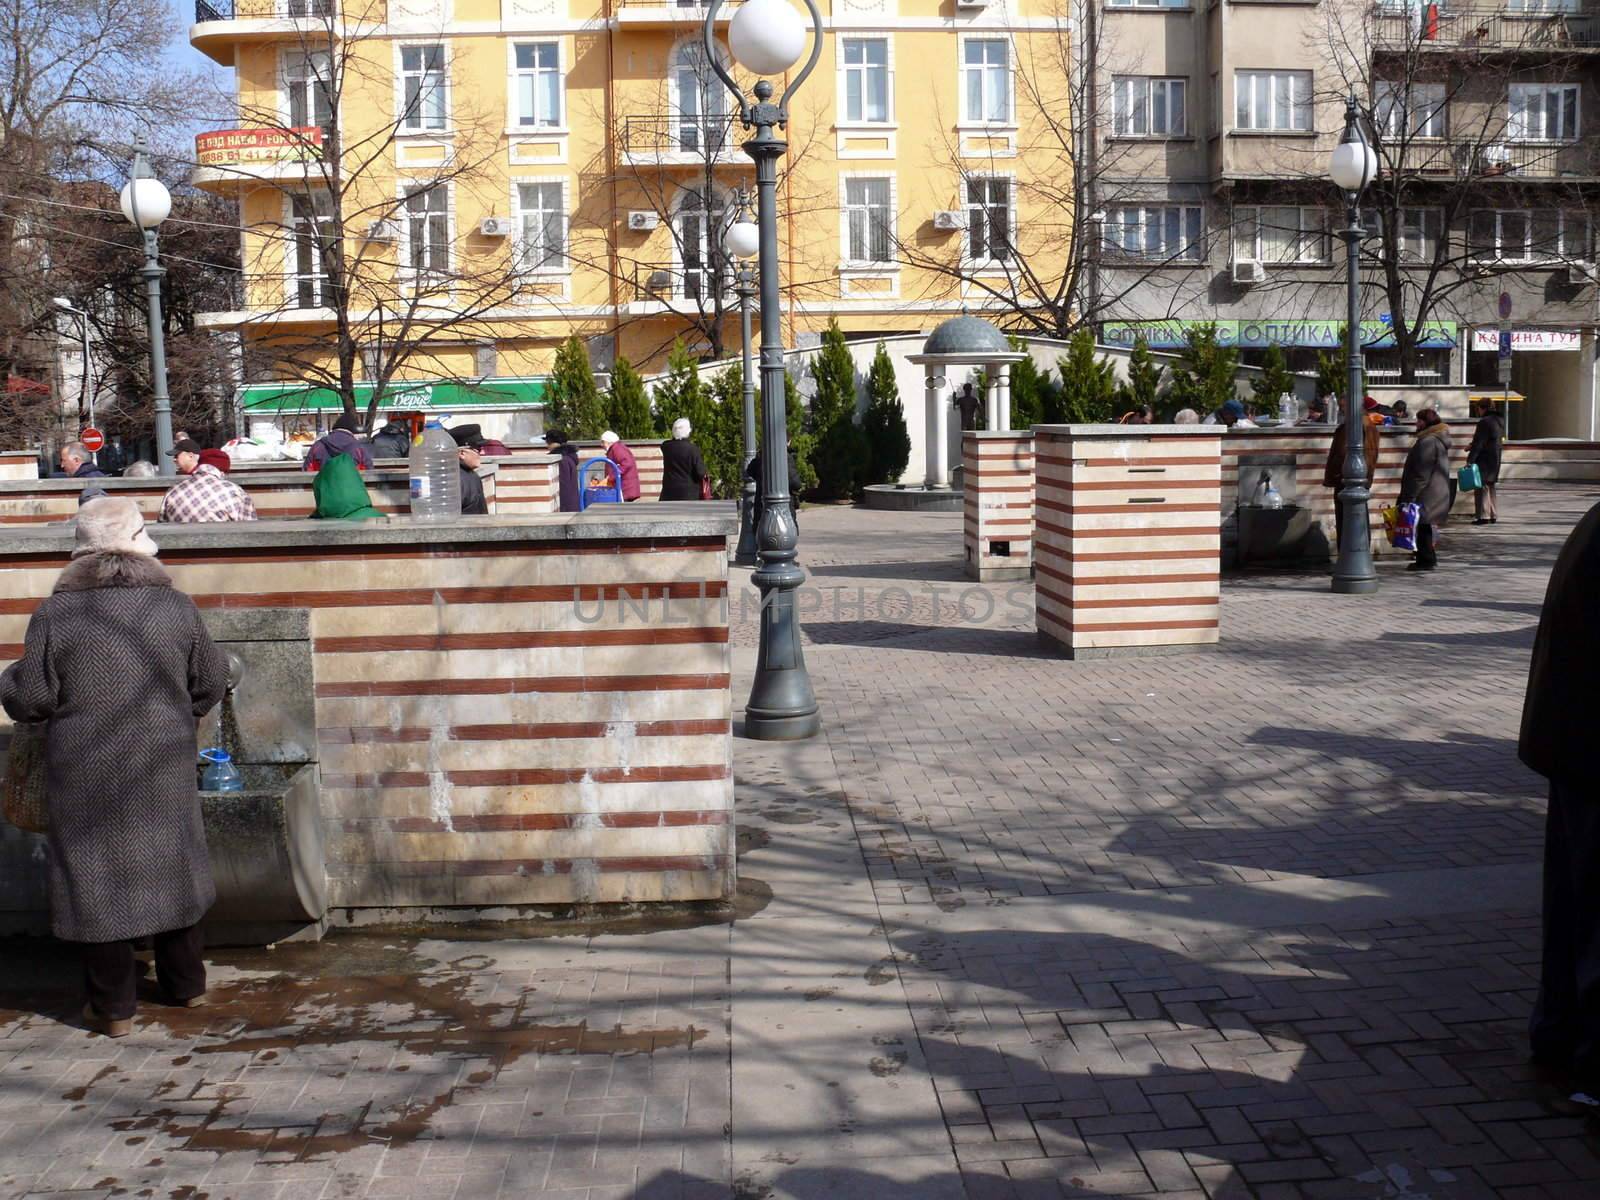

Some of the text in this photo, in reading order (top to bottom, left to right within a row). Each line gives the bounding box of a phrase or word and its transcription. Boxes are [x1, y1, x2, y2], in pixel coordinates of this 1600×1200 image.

[1244, 324, 1334, 343] ОПТИКА
[1478, 333, 1577, 344] КАИНА ТУР
